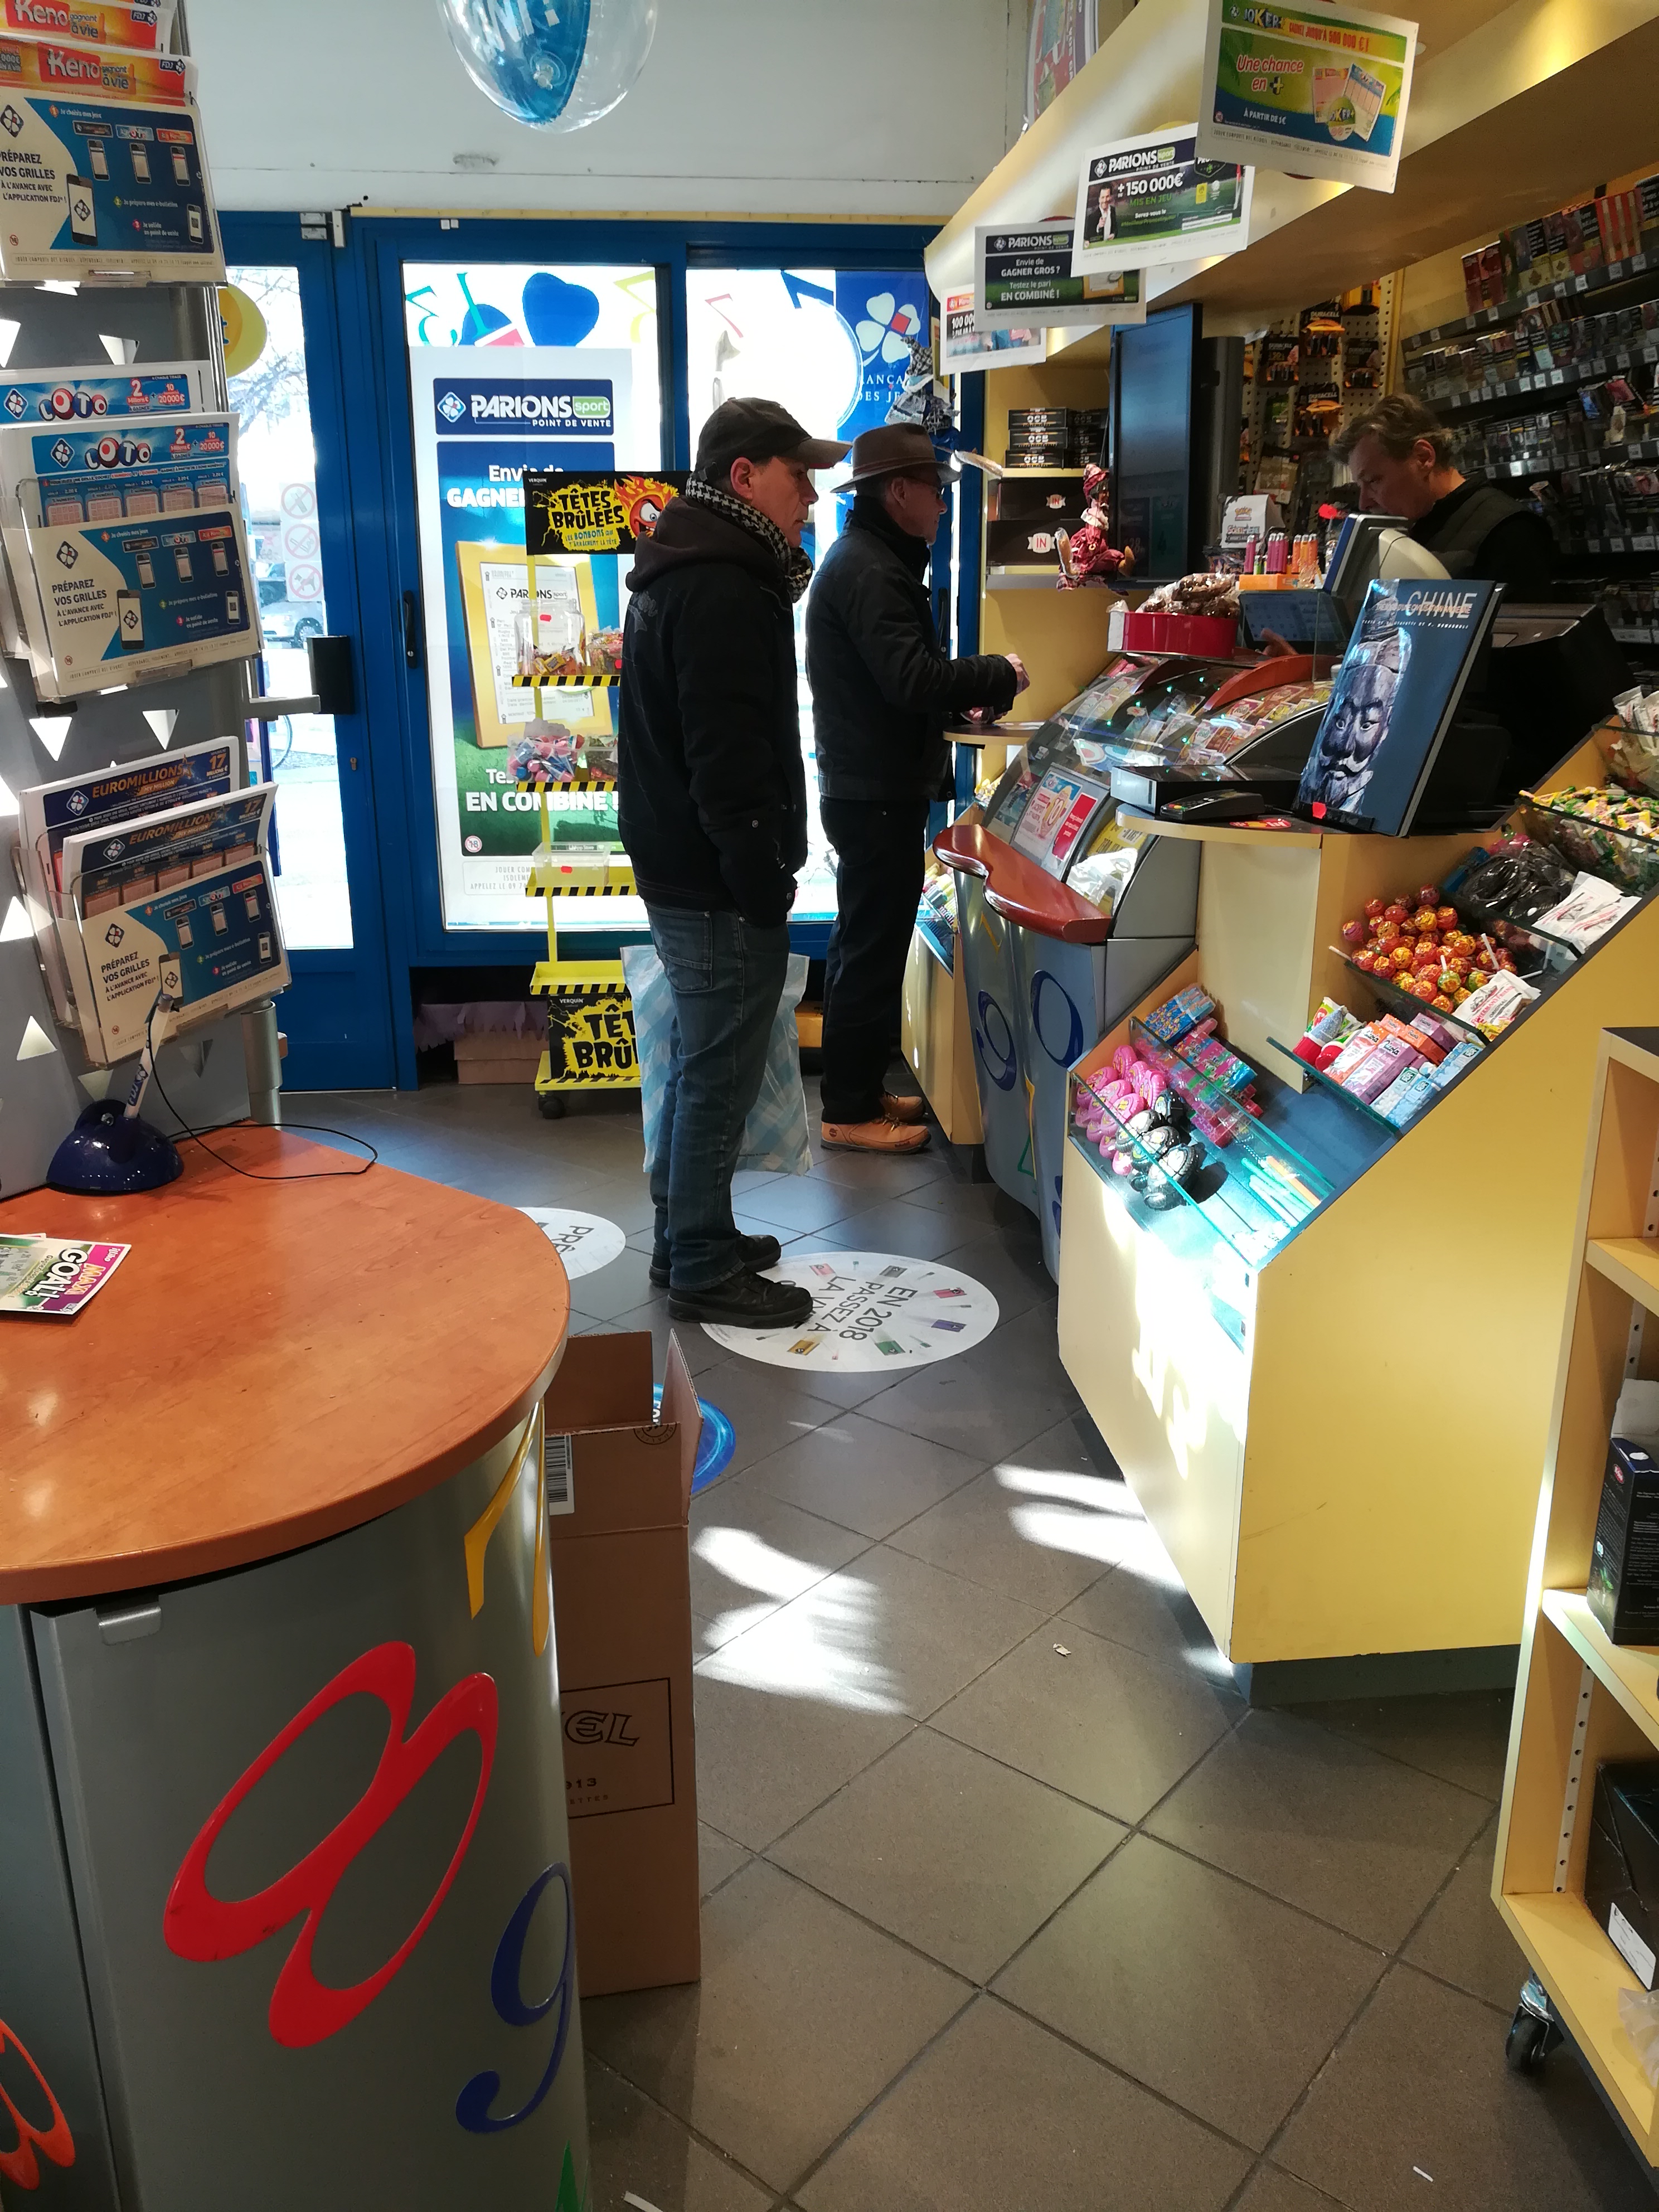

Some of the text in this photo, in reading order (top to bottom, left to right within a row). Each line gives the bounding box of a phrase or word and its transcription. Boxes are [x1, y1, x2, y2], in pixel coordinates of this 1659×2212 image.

[15, 0, 68, 26] Keno
[70, 13, 97, 22] gagnant
[133, 11, 145, 20] FDJ
[80, 24, 98, 38] vie
[1305, 25, 1327, 41] JUSQU'À
[1328, 30, 1341, 45] 500
[1342, 32, 1356, 49] 000
[1358, 36, 1364, 51] €
[47, 48, 100, 79] Keno
[161, 60, 173, 70] FDJ
[1236, 54, 1304, 74] Une chance
[111, 77, 129, 89] vie
[1251, 77, 1267, 91] en
[1243, 107, 1248, 118] À
[1249, 109, 1270, 122] PARTIR
[1270, 114, 1278, 123] DE
[0, 149, 42, 164] RÉPAREZ
[1108, 148, 1175, 173] PARIONS sport
[1160, 160, 1175, 168] VENTE
[18, 167, 55, 180] GRILLES
[1, 180, 6, 188] À
[7, 182, 36, 191] L'AVANCE
[1126, 179, 1148, 197] 150
[3, 192, 48, 202] L'APPLICATION
[1129, 192, 1172, 207] MIS EN JEU
[1007, 234, 1052, 249] PARIONS
[1015, 257, 1044, 267] Envie de
[1001, 266, 1033, 278] GAGNER
[1034, 265, 1055, 276] GROS
[1009, 279, 1051, 290] Testez le pari
[1001, 292, 1012, 302] EN
[1013, 288, 1055, 301] COMBINÉ
[952, 315, 964, 330] 100
[131, 379, 143, 397] 2
[167, 382, 174, 391] 10
[40, 389, 107, 420] LOTO
[470, 394, 610, 419] PARIONS sport
[532, 419, 612, 428] POINT DE VENTE
[1026, 414, 1047, 423] OCB
[175, 428, 185, 444] 2
[1028, 434, 1049, 443] OCB
[85, 439, 151, 469] LOTO
[1023, 455, 1045, 464] OCB
[447, 488, 525, 508] GAGNE
[557, 488, 611, 511] TÊTES
[551, 505, 625, 530] BRÛLÉES
[606, 537, 618, 546] TÊTE
[1036, 537, 1047, 549] IN
[52, 578, 95, 594] PRÉPAREZ
[510, 588, 552, 599] PARNS
[54, 589, 108, 606] VOS GRILLES
[1405, 590, 1478, 619] CHINE
[57, 603, 105, 617] À L'AVANCE AVEC
[58, 614, 101, 628] L'APPLICATION
[209, 753, 227, 769] 17
[92, 762, 185, 799] EUROMILLIONS
[152, 779, 176, 791] MILLION
[244, 799, 263, 813] 17
[465, 792, 497, 812] EN
[129, 809, 220, 845] EUROMILLIONS
[100, 950, 139, 973] PRÉPAREZ
[103, 958, 151, 983] VOS GRILLES
[110, 976, 135, 992] L'AVANCE
[134, 971, 148, 983] AVEC
[106, 983, 145, 1002] L'APPLICATION
[1489, 998, 1507, 1018] ORIGINAL
[583, 1003, 636, 1041] TÊT
[1363, 1026, 1380, 1044] Ricola
[1379, 1039, 1400, 1056] Ricola
[23, 1248, 89, 1299] GOAL!
[64, 1263, 106, 1296] MAXI
[818, 1275, 857, 1291] LA
[821, 1281, 885, 1323] PASSEZ
[838, 1286, 918, 1341] EN 2018
[561, 1709, 641, 1747] EL
[569, 1794, 609, 1805] ETTES
